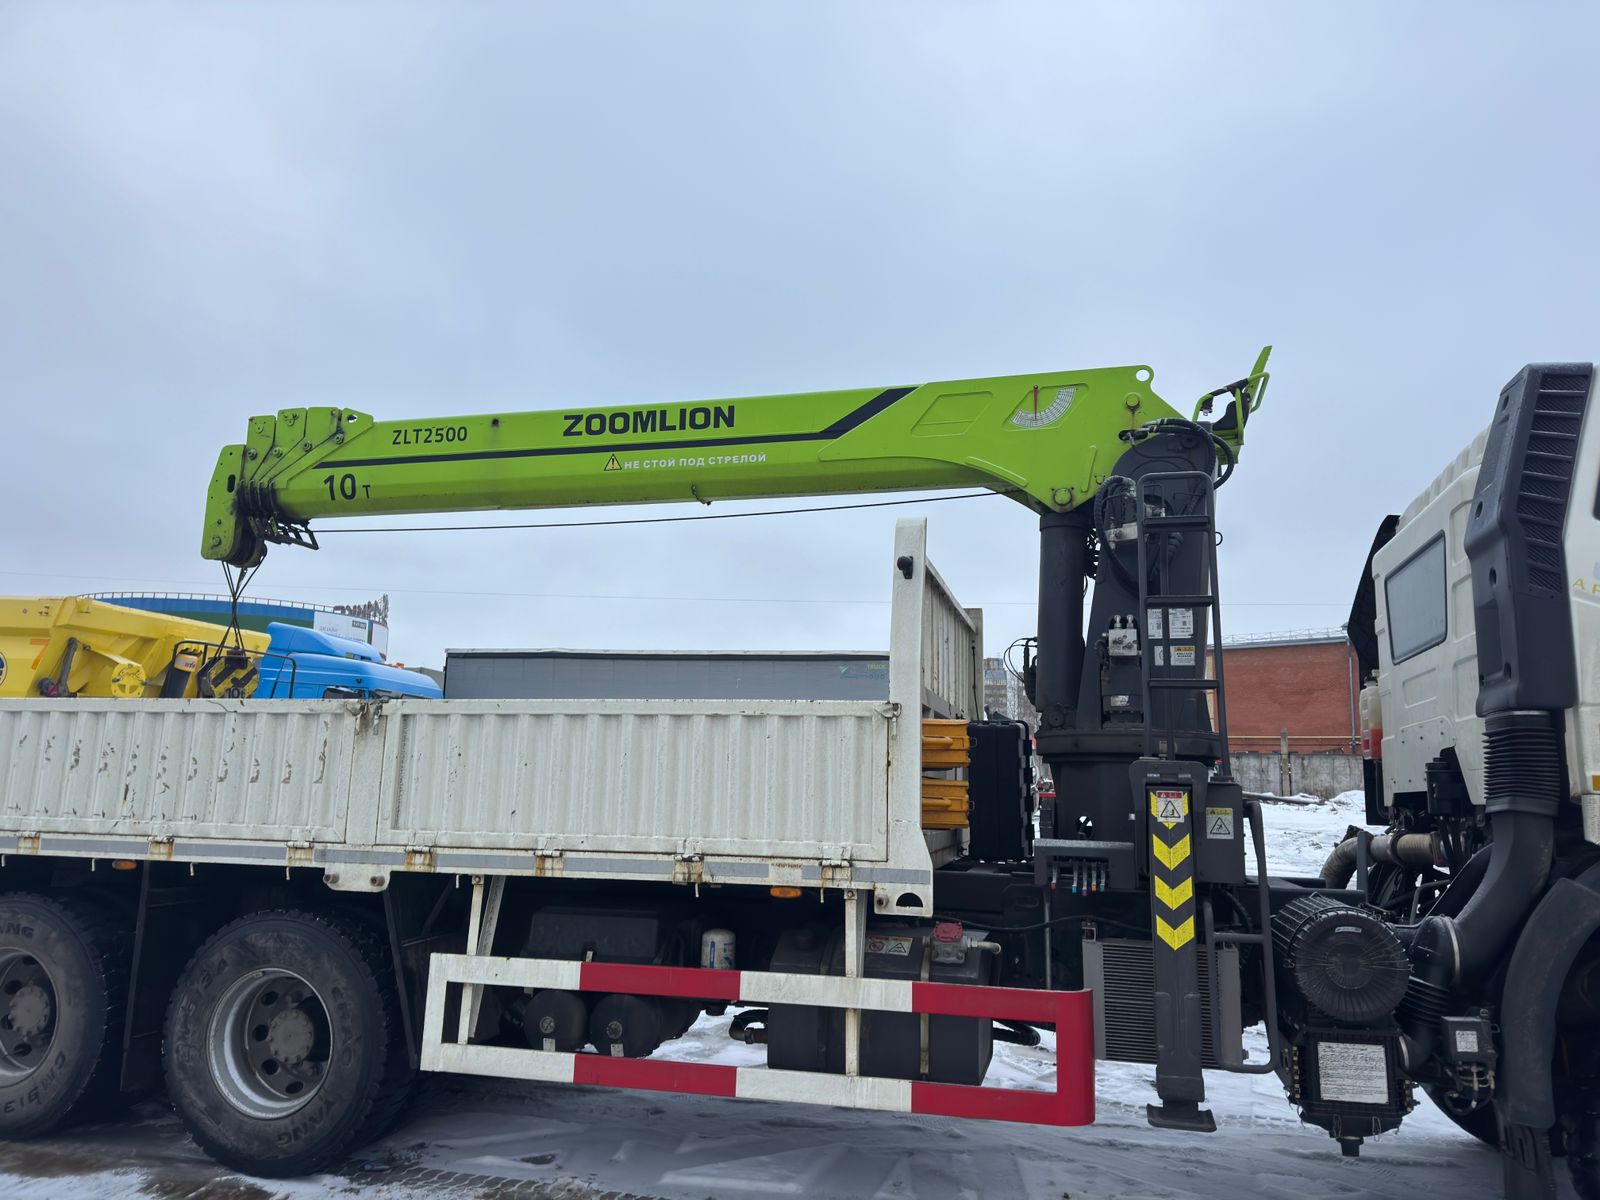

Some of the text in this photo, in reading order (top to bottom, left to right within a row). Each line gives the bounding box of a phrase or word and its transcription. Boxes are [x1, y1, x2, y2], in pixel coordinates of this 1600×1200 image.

[562, 405, 735, 437] ZOOMLION
[392, 426, 468, 445] ZLT2500
[624, 452, 767, 469] НЕ СТОЙ ПОД СТРЕЛОЙ
[323, 473, 357, 500] 10
